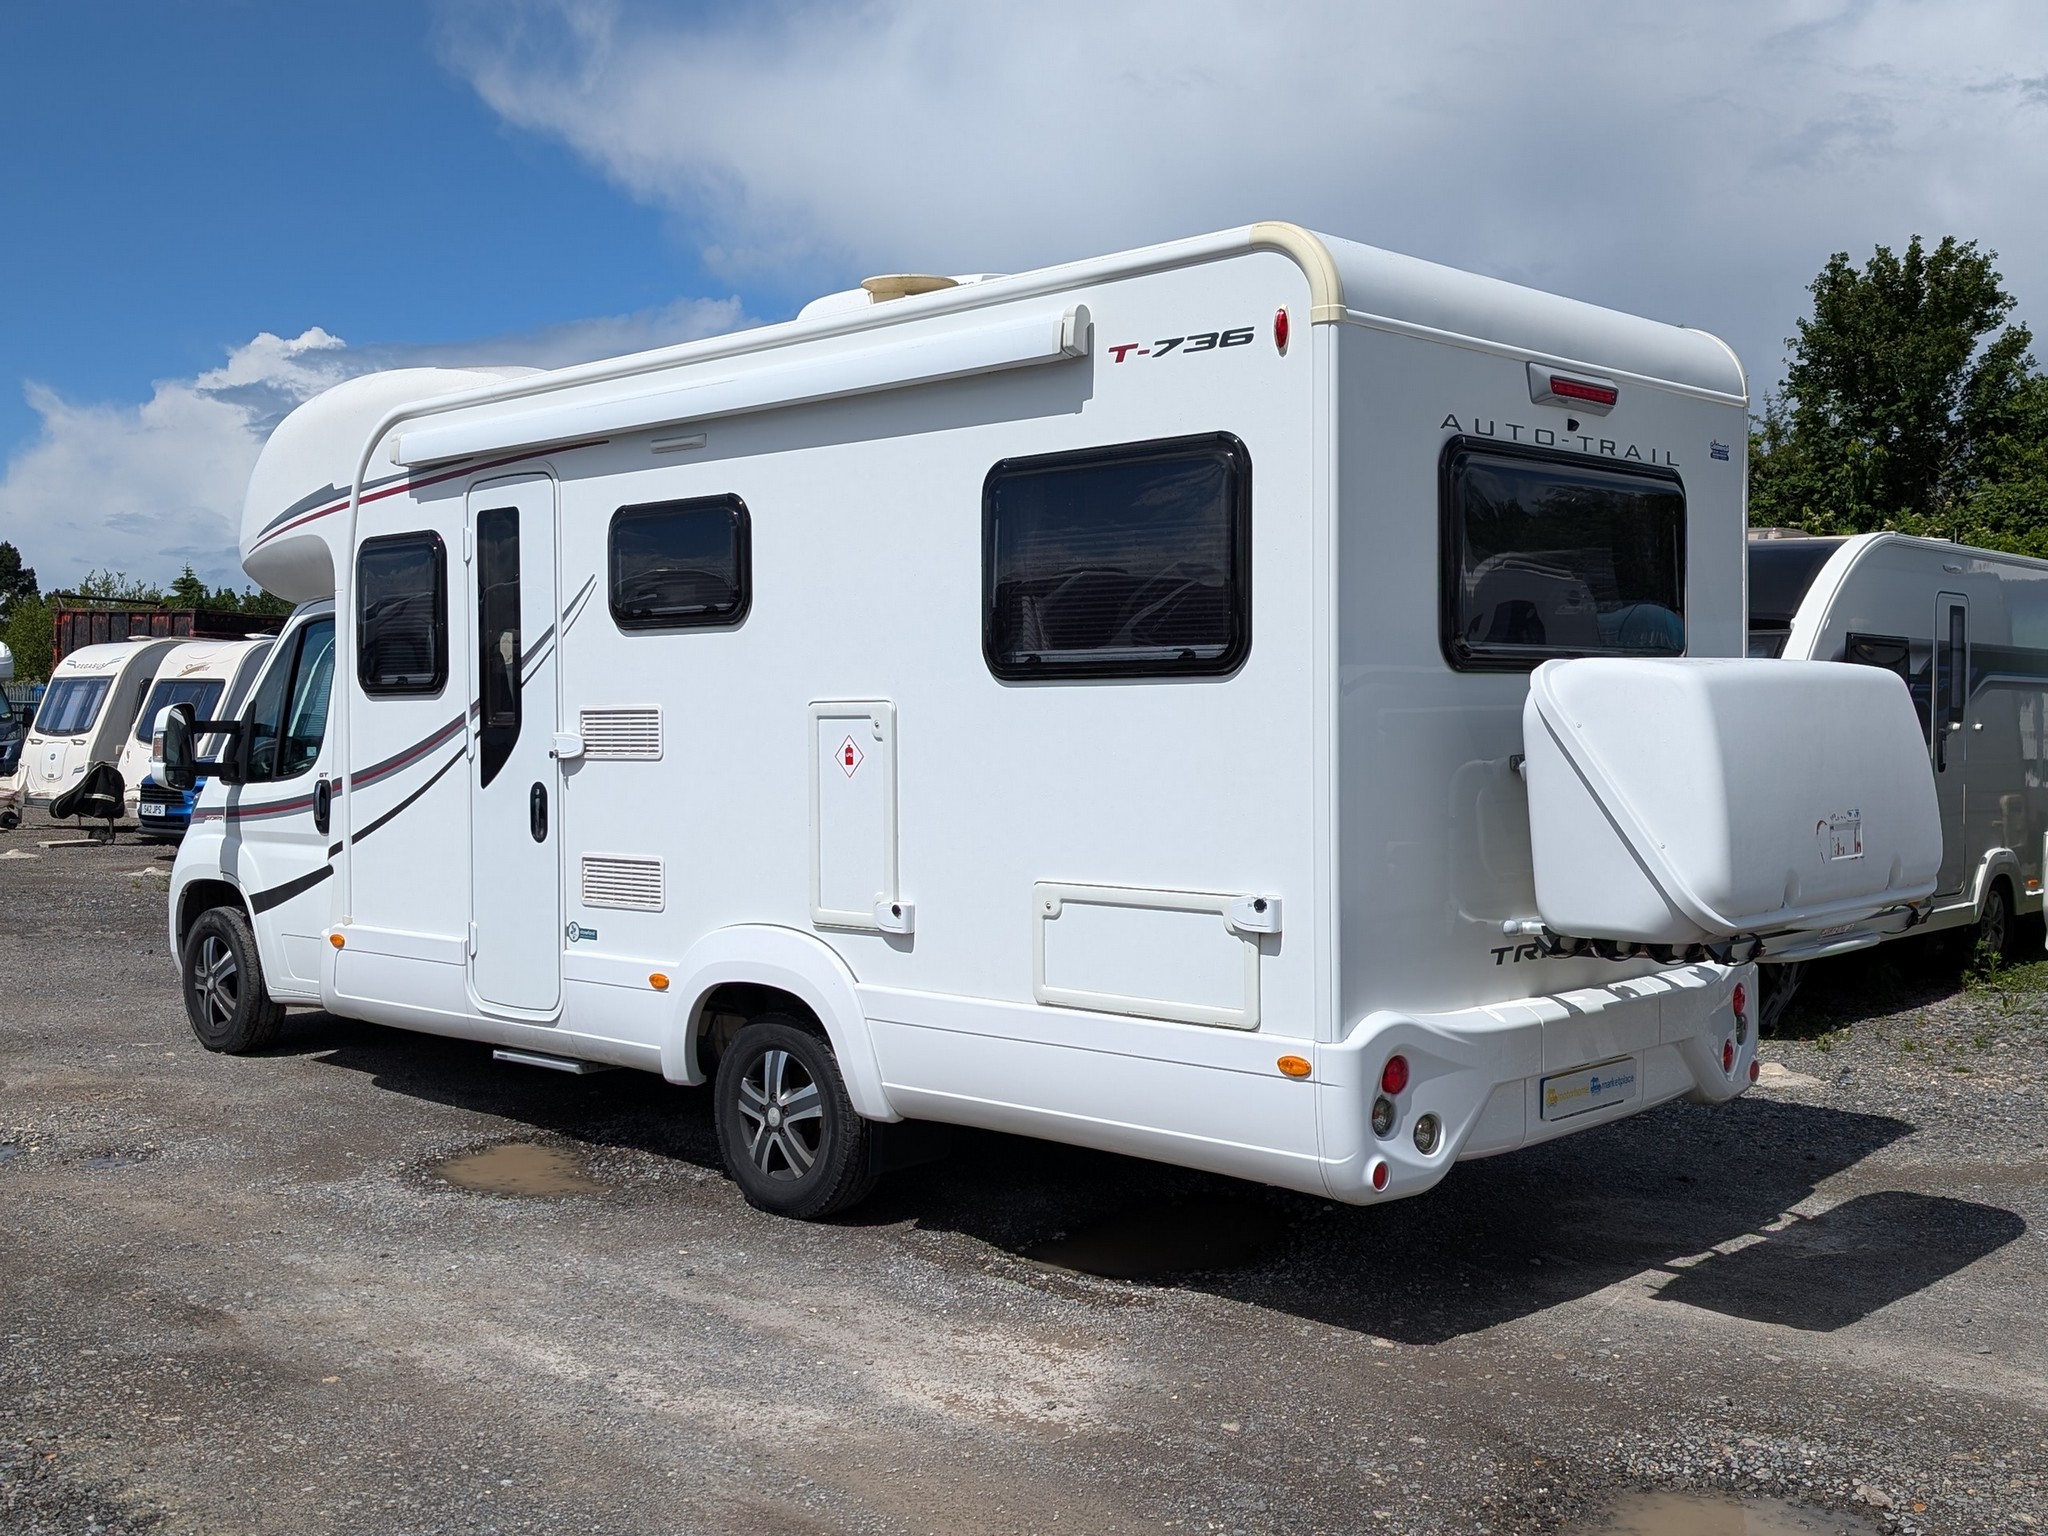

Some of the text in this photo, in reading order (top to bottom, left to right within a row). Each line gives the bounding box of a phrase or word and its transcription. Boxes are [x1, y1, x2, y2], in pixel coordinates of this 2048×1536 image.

[1108, 326, 1255, 363] T-736
[1440, 413, 1680, 467] AUTO-TRAIL
[1490, 942, 1547, 966] TR
